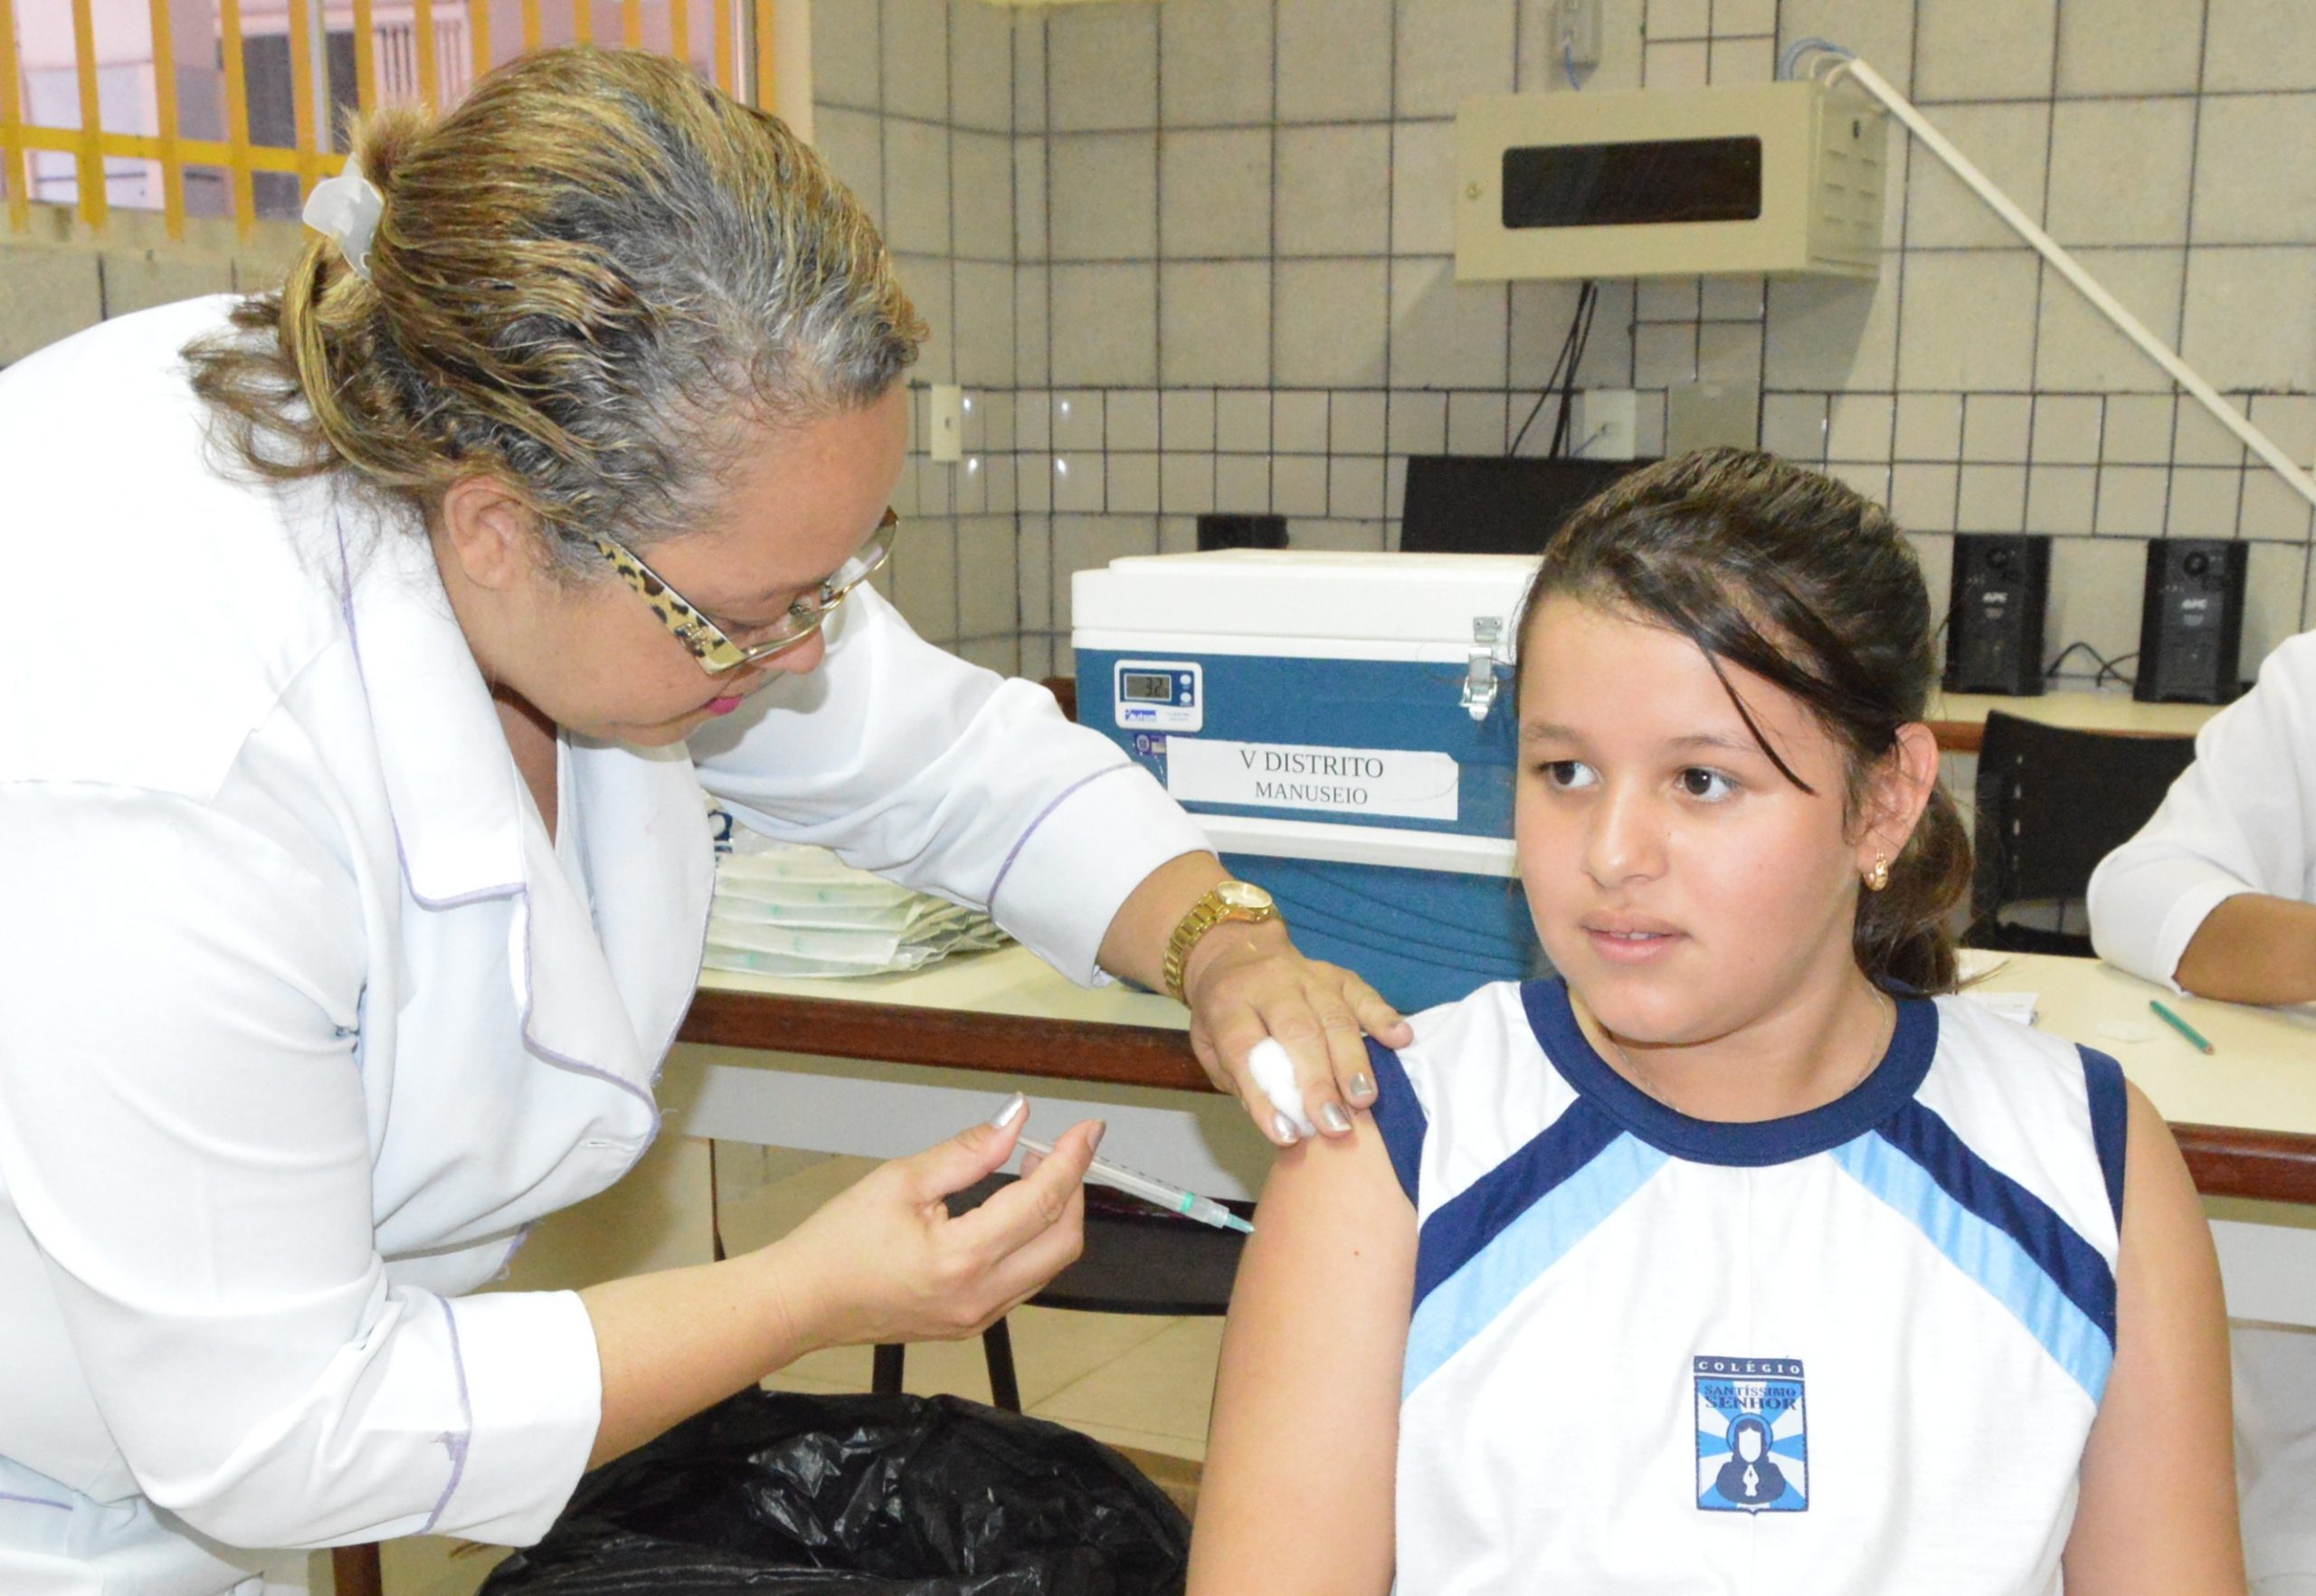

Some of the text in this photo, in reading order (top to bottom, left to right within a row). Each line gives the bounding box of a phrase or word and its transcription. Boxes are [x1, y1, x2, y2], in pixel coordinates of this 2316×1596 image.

[1239, 749, 1383, 778] V DISTRITO
[1256, 781, 1369, 804] MANUSEIO
[1705, 1396, 1797, 1411] SENHOR
